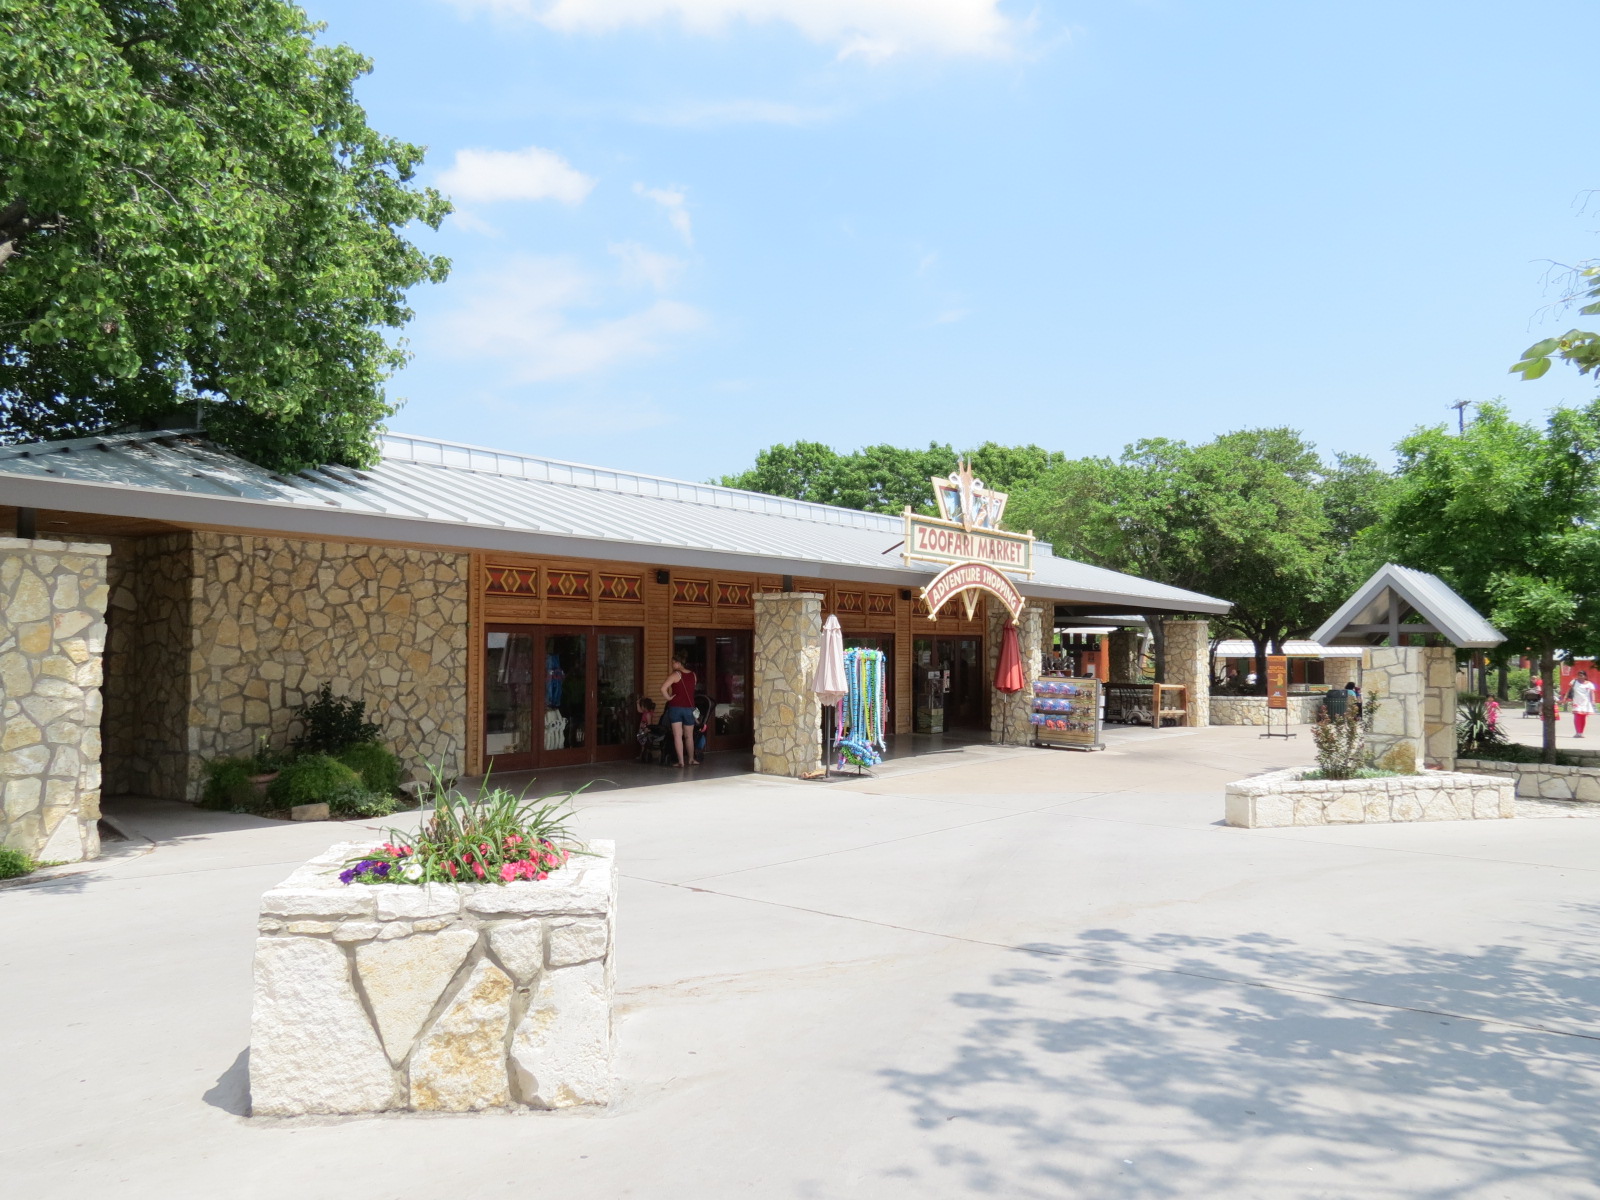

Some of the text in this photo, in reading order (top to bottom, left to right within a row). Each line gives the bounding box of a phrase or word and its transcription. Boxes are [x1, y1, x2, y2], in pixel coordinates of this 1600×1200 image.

[918, 527, 1022, 563] ZOOFARI MARKET
[932, 567, 1018, 609] ADVENTURE SHOPPING
